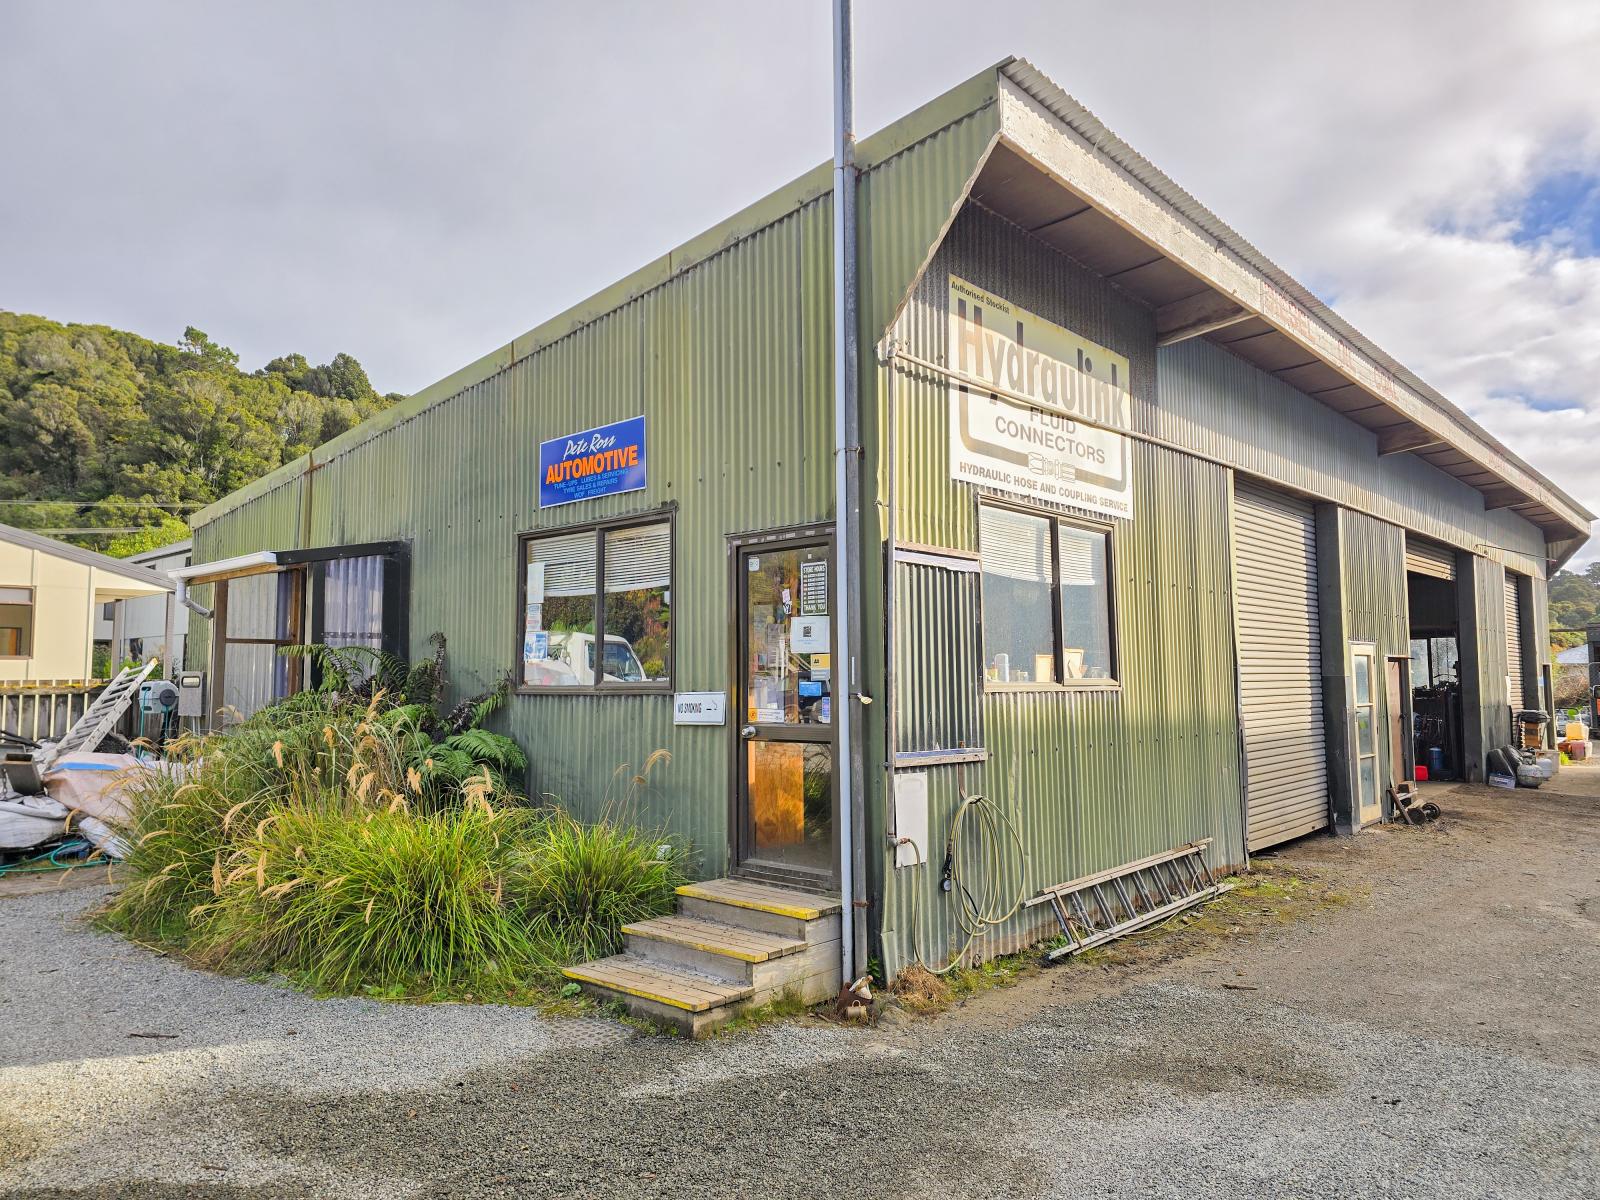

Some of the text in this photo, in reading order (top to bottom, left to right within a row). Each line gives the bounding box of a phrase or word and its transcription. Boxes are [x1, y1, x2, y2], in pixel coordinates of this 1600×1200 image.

[951, 281, 1010, 315] Authorised Stockist
[958, 297, 1126, 429] Hydraulink
[995, 415, 1106, 465] CONNECTORS
[1030, 406, 1076, 434] FLUID
[546, 444, 638, 485] AUTOMOTIVE
[563, 433, 616, 460] Pete Ross
[959, 461, 1129, 512] HYDRAULIC HOSE AND COUPLING SERVICE
